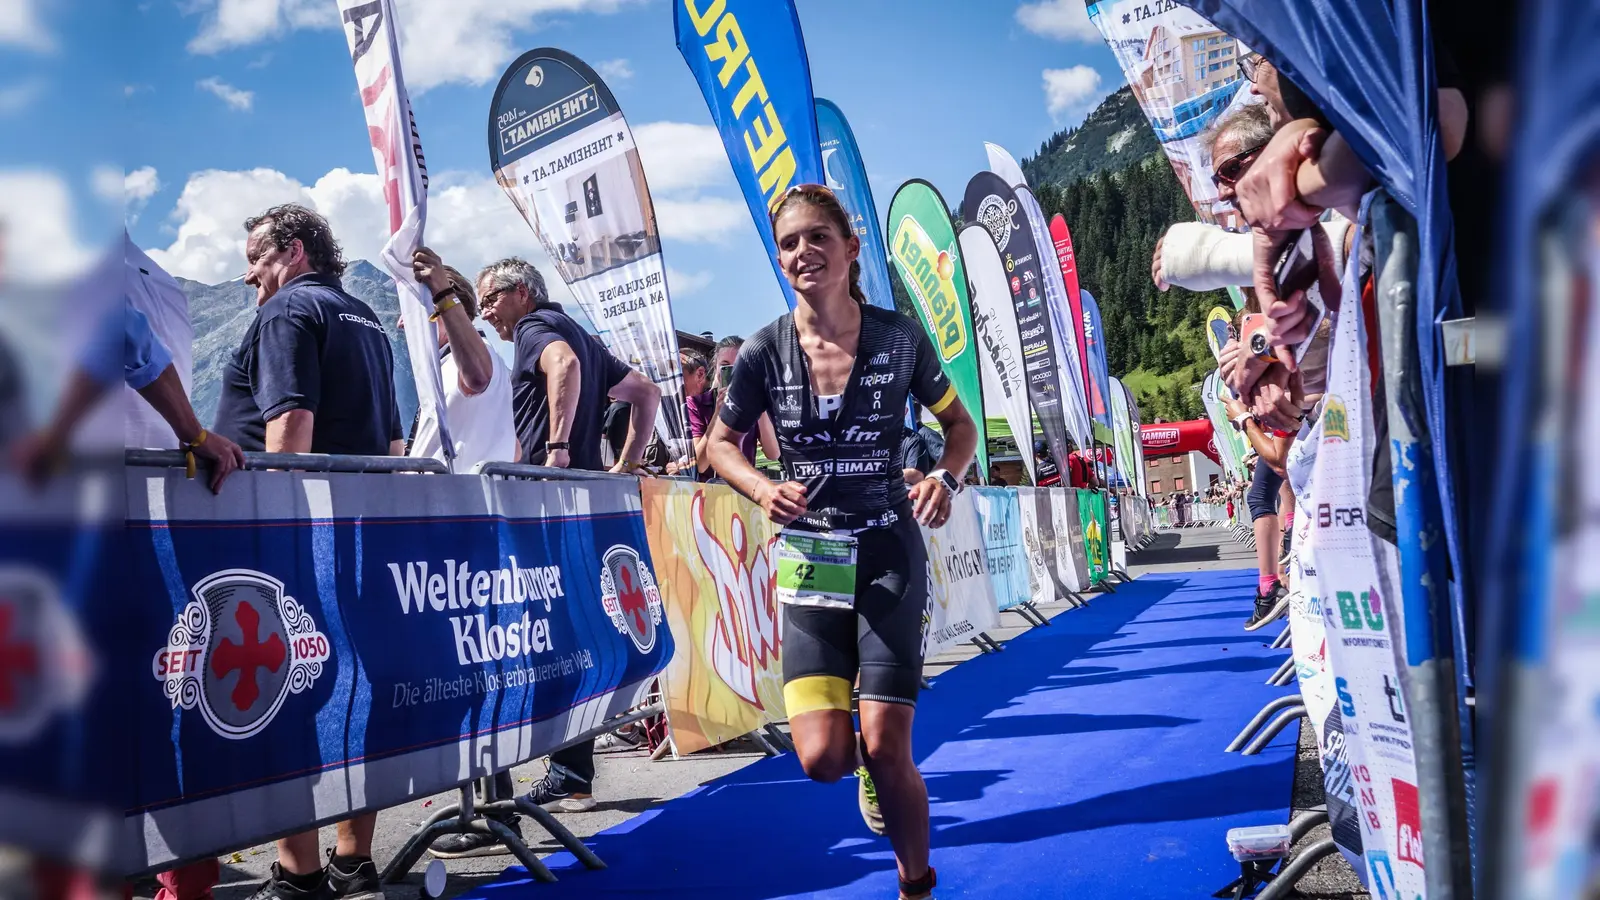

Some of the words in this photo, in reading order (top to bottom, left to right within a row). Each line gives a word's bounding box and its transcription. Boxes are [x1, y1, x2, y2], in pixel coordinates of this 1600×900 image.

[387, 555, 565, 615] Weltenburger
[795, 563, 815, 580] 42
[604, 597, 620, 613] SEIT
[646, 588, 660, 604] 1050
[293, 635, 328, 660] 1050
[449, 611, 554, 666] Kloster
[157, 648, 202, 679] SEIT
[392, 682, 419, 709] Die
[424, 674, 473, 704] älteste
[475, 657, 561, 694] Klosterbrauerei
[574, 649, 594, 672] Welt
